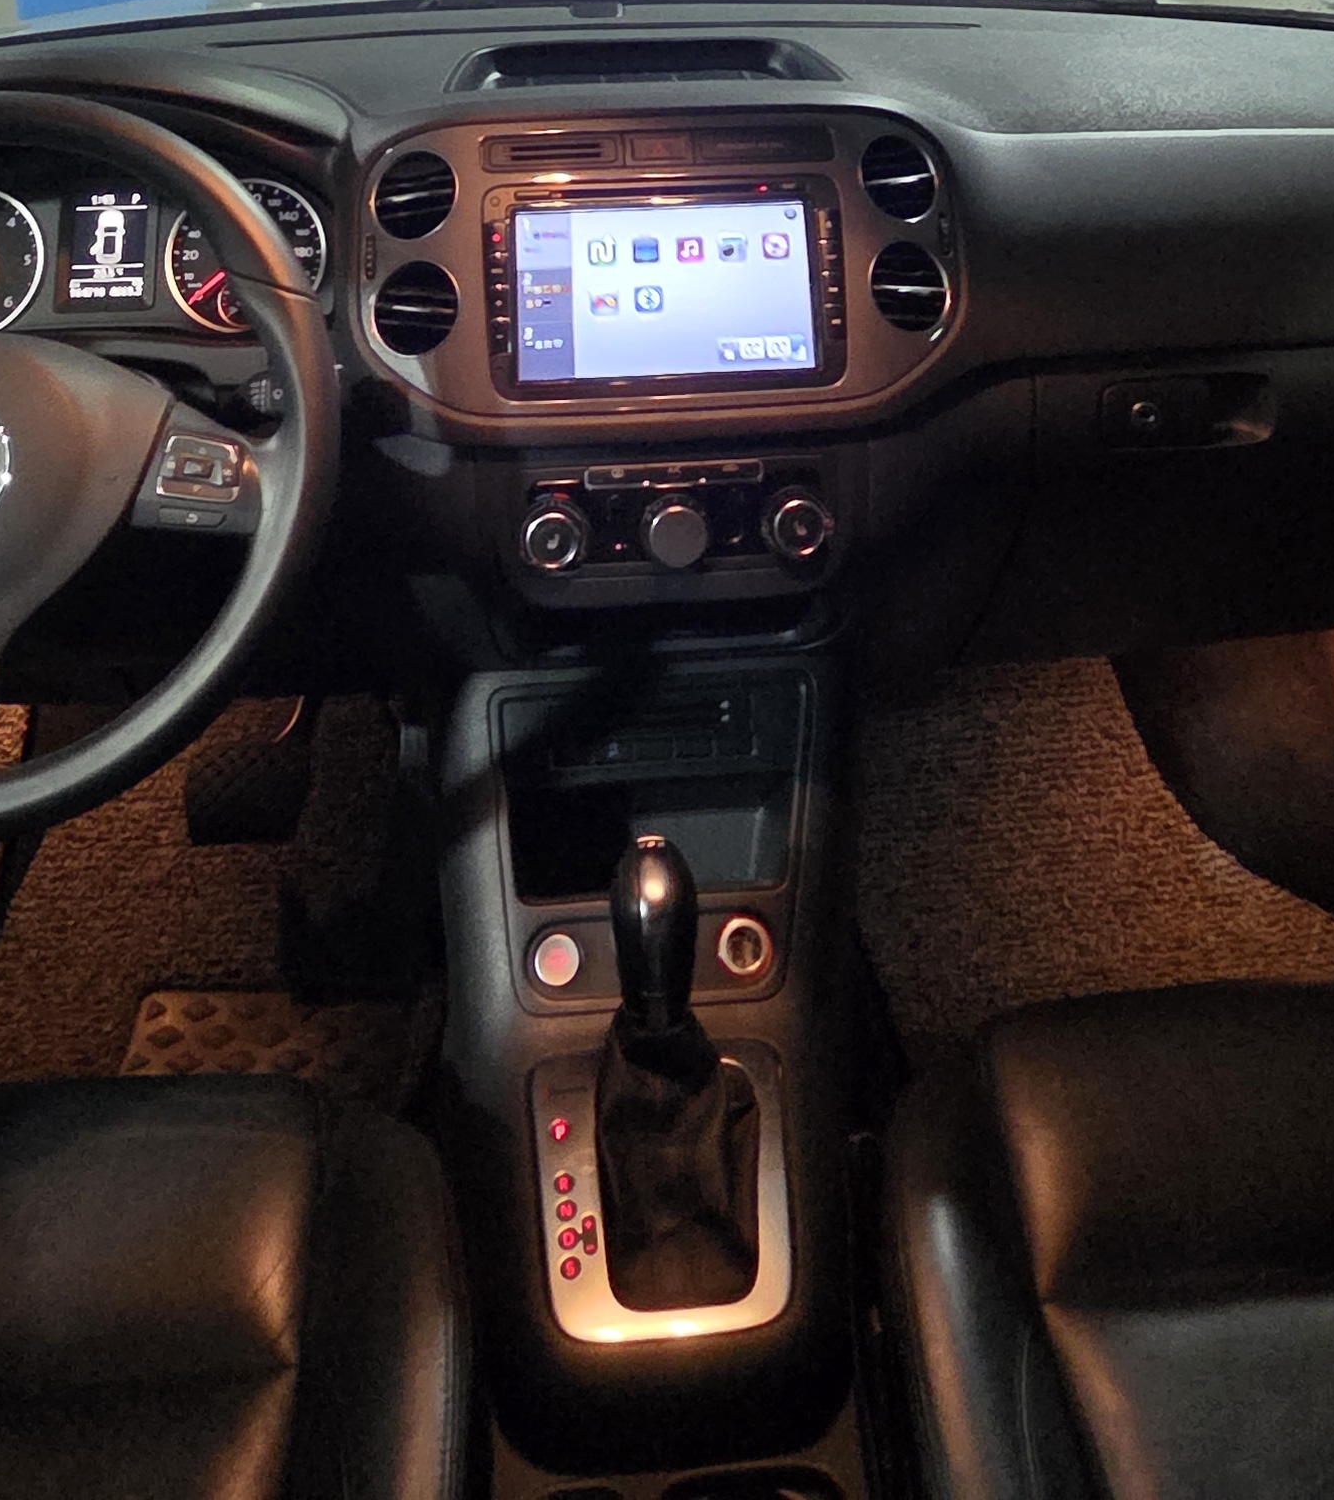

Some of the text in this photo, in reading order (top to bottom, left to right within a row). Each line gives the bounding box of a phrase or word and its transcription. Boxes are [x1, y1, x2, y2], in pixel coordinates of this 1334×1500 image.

[6, 217, 16, 228] 4
[24, 254, 31, 266] 5
[182, 250, 199, 260] 20
[4, 296, 14, 308] 6
[555, 1124, 566, 1141] P
[558, 1177, 569, 1191] R
[560, 1203, 573, 1217] N
[562, 1231, 575, 1247] D
[566, 1260, 576, 1276] S
